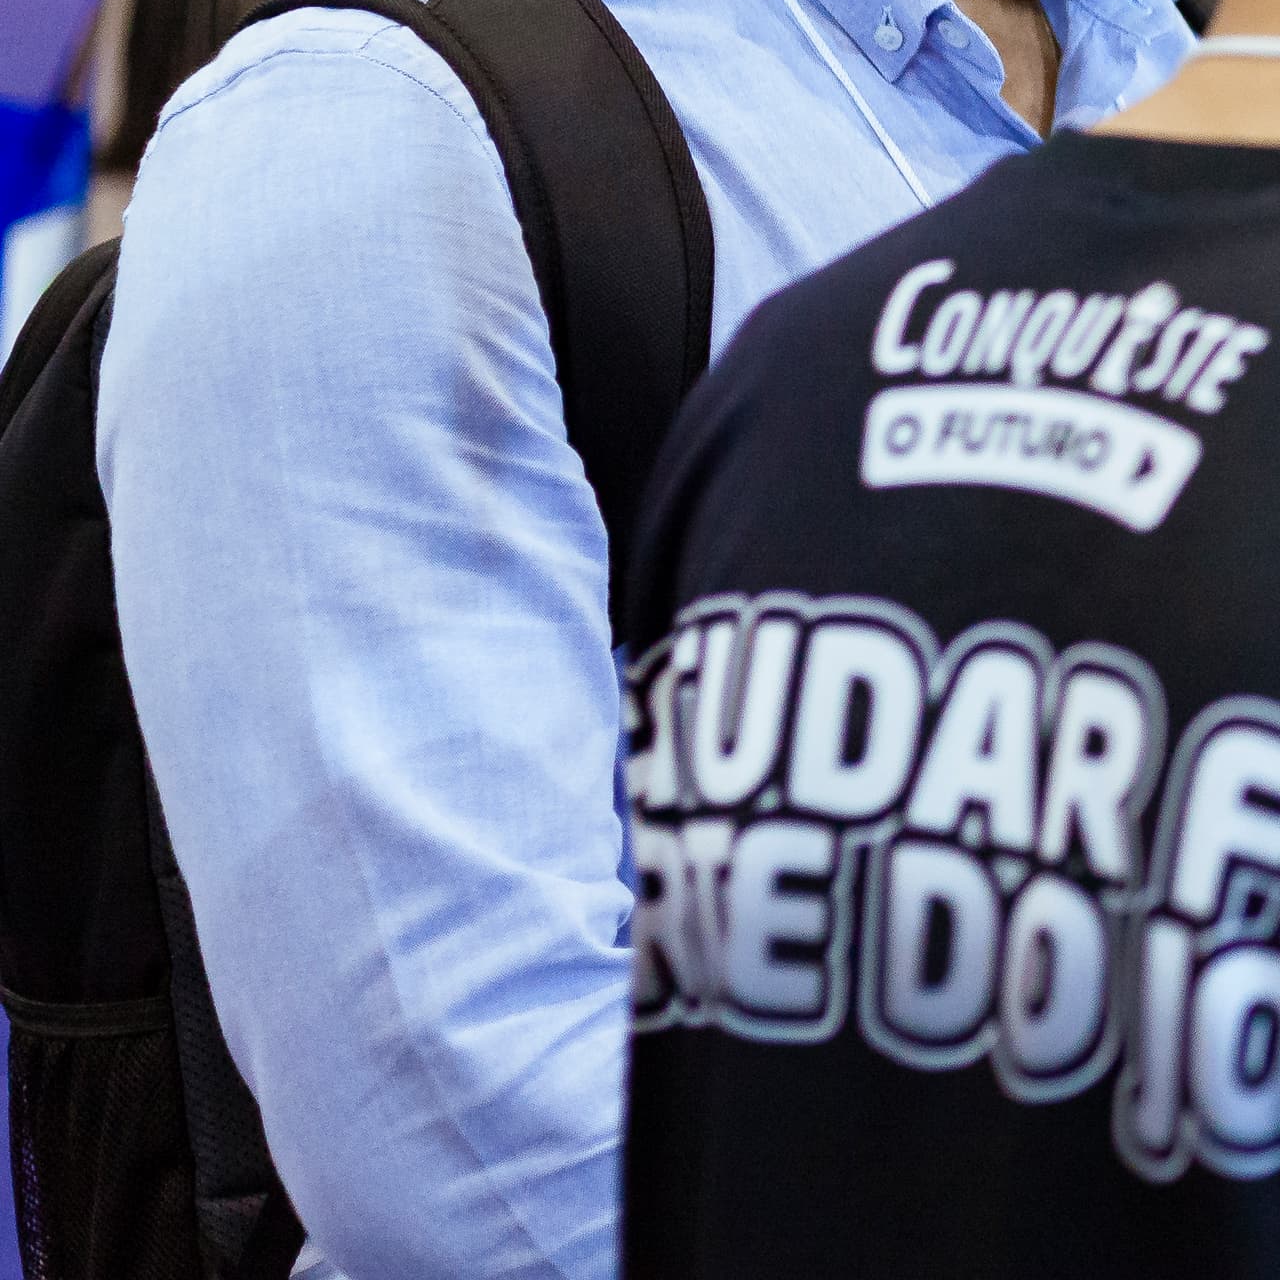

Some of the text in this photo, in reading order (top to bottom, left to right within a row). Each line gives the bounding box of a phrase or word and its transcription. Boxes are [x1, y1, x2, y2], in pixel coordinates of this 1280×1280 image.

[885, 409, 1112, 473] O FUTURO
[880, 840, 1108, 1076] DO
